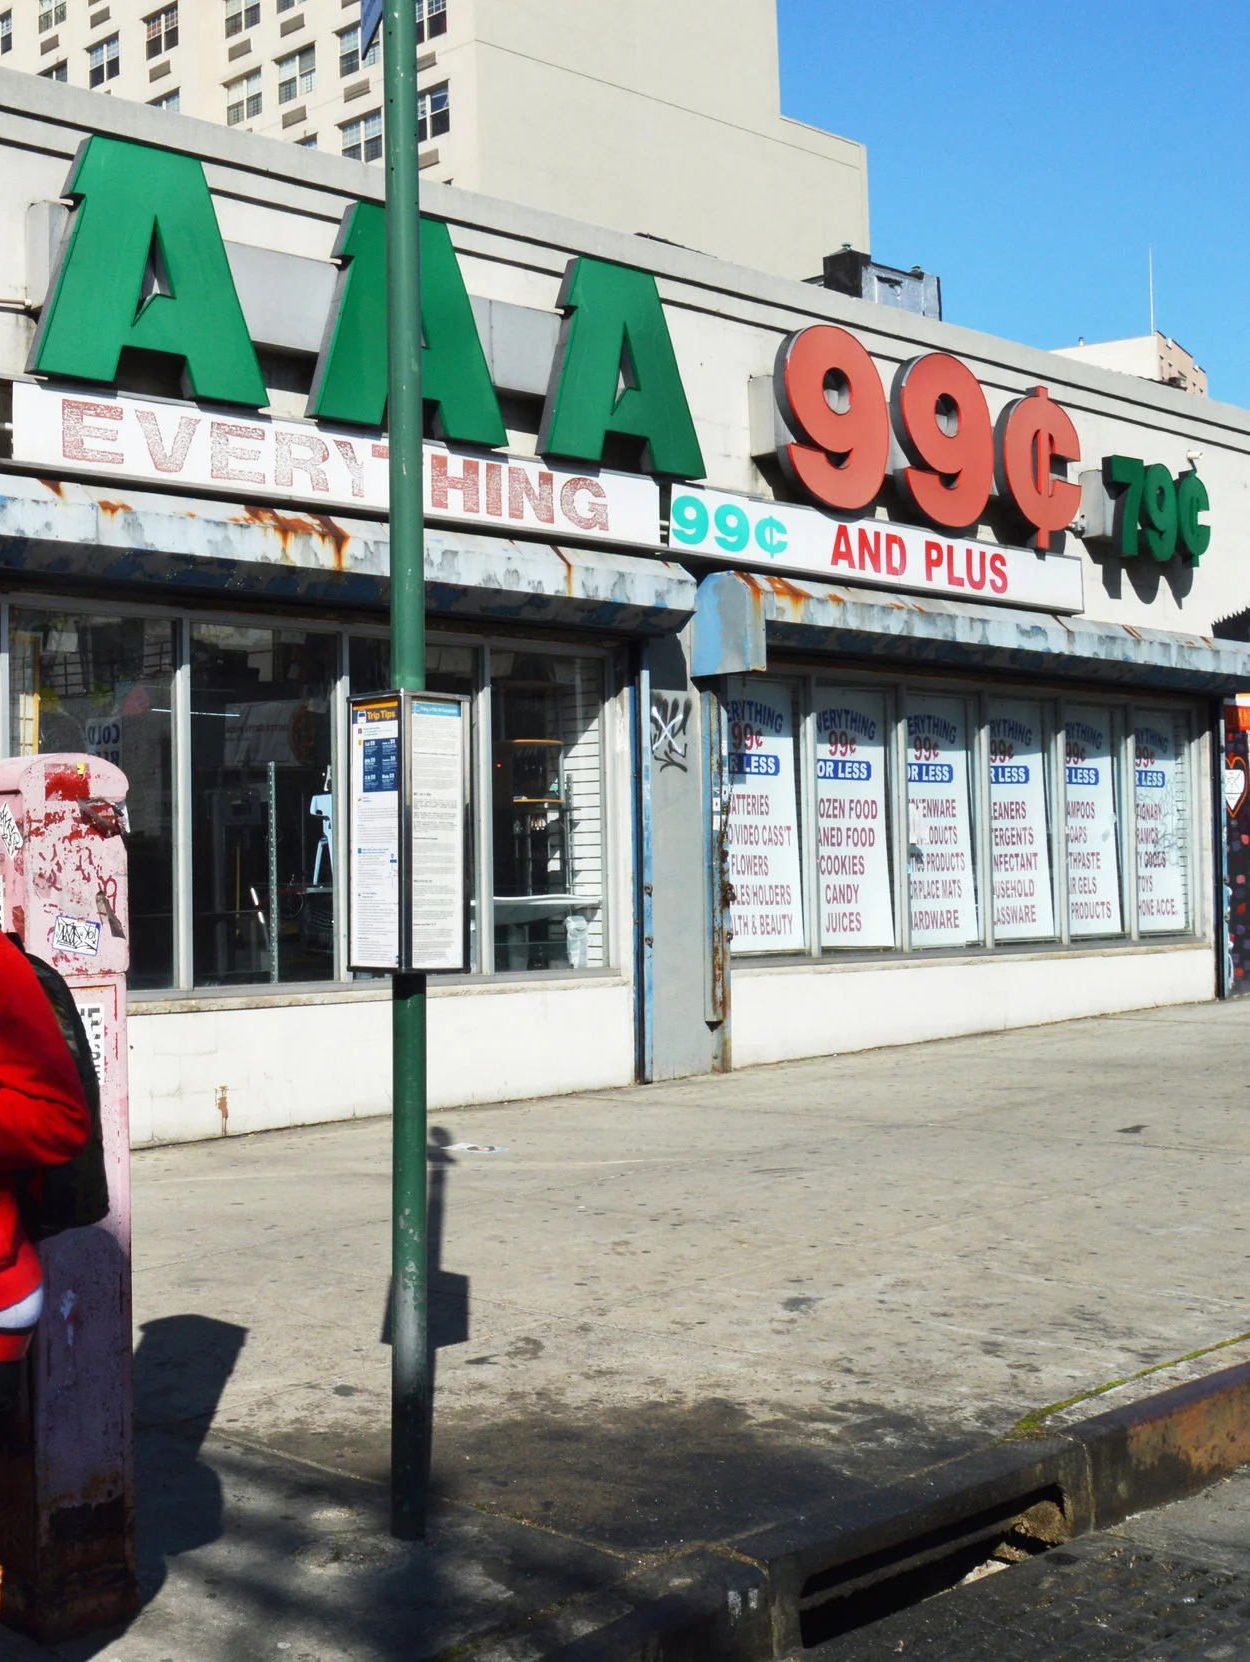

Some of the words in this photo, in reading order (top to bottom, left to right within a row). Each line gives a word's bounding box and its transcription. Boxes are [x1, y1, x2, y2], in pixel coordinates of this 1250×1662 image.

[779, 324, 1081, 549] 99¢
[61, 398, 610, 531] EVERYHING
[1104, 455, 1211, 568] 79¢
[671, 494, 789, 559] 99¢
[830, 523, 907, 577] AND
[924, 540, 1009, 595] PLUS
[367, 711, 381, 721] Trip
[381, 709, 396, 719] Tips
[732, 722, 763, 750] 99¢
[829, 729, 856, 757] 99¢
[913, 735, 939, 761] 99¢
[744, 756, 776, 774] LESS
[817, 761, 834, 777] OR
[838, 762, 868, 779] LESS
[922, 765, 950, 782] LESS
[998, 767, 1026, 782] LESS
[1072, 769, 1096, 783] LESS
[1142, 772, 1163, 786] LESS
[729, 794, 769, 816] ATTERIES
[819, 798, 845, 819] OZEN
[849, 799, 878, 819] FOOD
[991, 800, 1027, 820] EANERS
[846, 827, 876, 847] FOOD
[992, 826, 1034, 847] ERGENTS
[1068, 825, 1087, 843] OAPS
[731, 854, 769, 876] FLOWERS
[819, 854, 865, 875] COOKIES
[926, 852, 965, 872] PRODUCTS
[752, 884, 792, 905] HOLDERS
[825, 883, 860, 904] CANDY
[941, 879, 963, 898] MATS
[993, 879, 1035, 899] USEHOLD
[1077, 876, 1097, 894] GELS
[911, 909, 960, 930] ARDWARE
[1071, 901, 1111, 920] PRODUCTS
[752, 914, 757, 935] &
[759, 914, 793, 935] BEAUTY
[825, 911, 862, 933] JUICES
